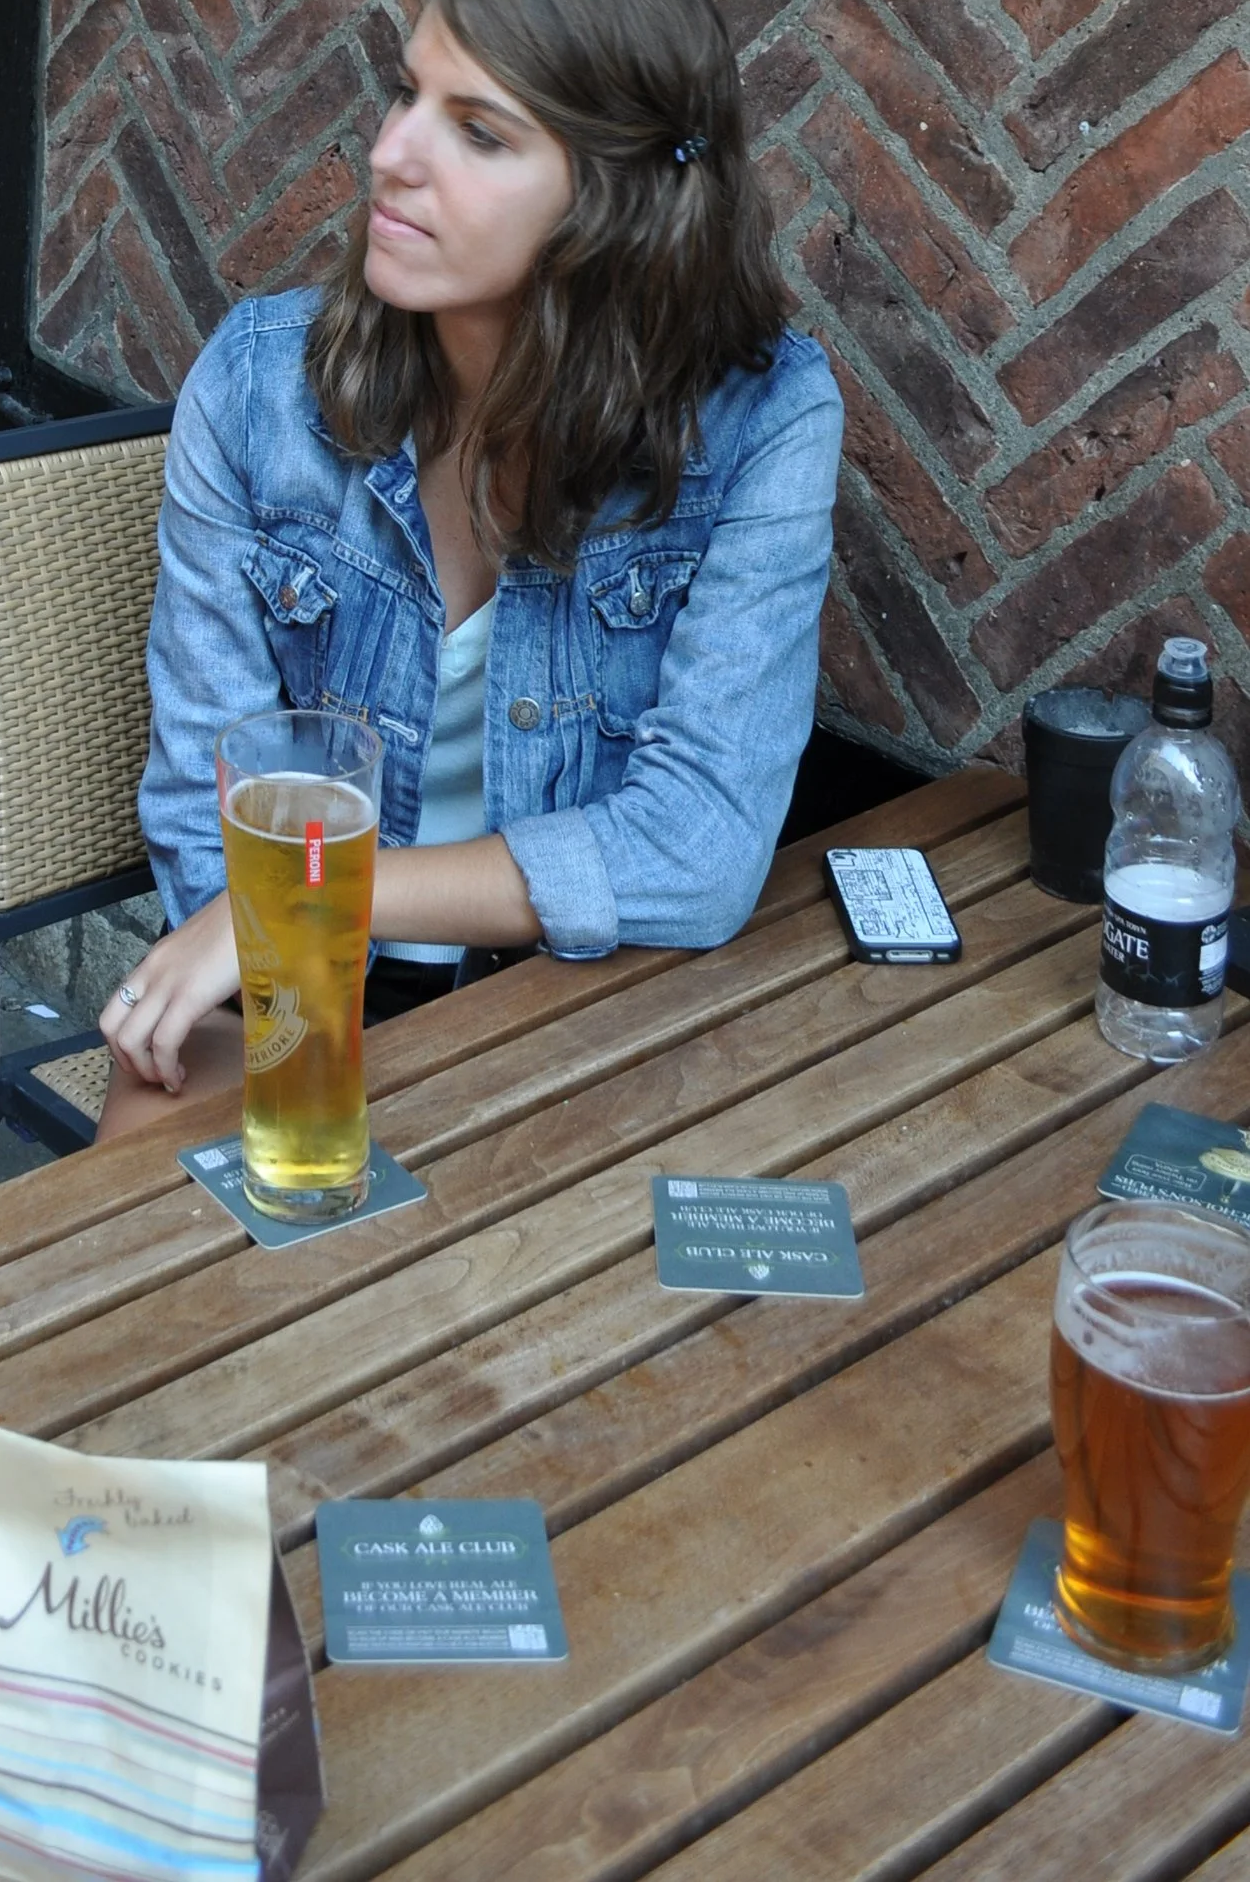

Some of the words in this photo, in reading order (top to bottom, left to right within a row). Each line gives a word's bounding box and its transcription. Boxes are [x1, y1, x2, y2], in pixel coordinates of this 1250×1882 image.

[309, 838, 321, 883] PERONI
[686, 1246, 736, 1258] CLUB
[740, 1248, 774, 1259] ALE
[779, 1250, 828, 1262] CASK
[354, 1541, 409, 1554] CASK
[414, 1541, 454, 1554] ALE
[458, 1541, 516, 1554] CLUB
[409, 1581, 445, 1590] LOVE
[343, 1591, 428, 1603] BECOME
[433, 1591, 447, 1602] A
[452, 1590, 539, 1602] MEMBER
[120, 1643, 223, 1692] COOKIES
